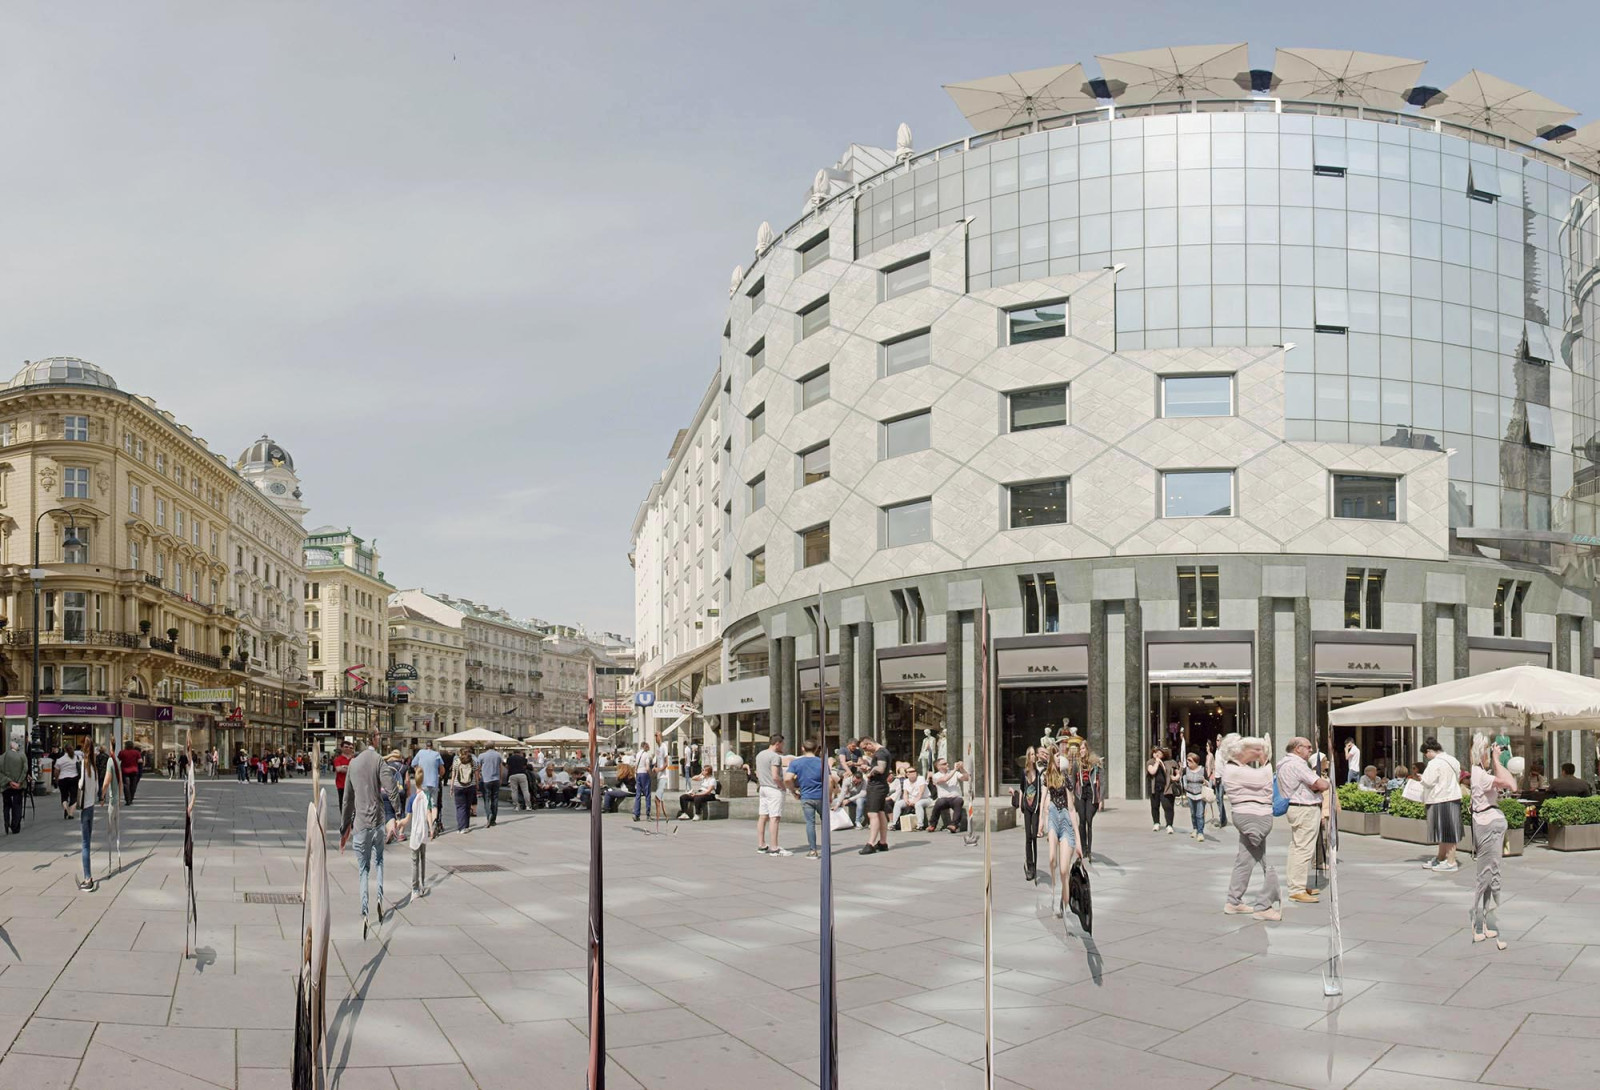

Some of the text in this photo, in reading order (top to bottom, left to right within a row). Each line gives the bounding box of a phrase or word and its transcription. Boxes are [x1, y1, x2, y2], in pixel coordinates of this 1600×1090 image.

[1027, 664, 1058, 673] ZARA
[1183, 661, 1217, 669] ZARA
[1347, 661, 1381, 670] ZARA
[902, 672, 926, 680] ZARA
[639, 694, 652, 705] U
[60, 703, 97, 711] Marionnaud
